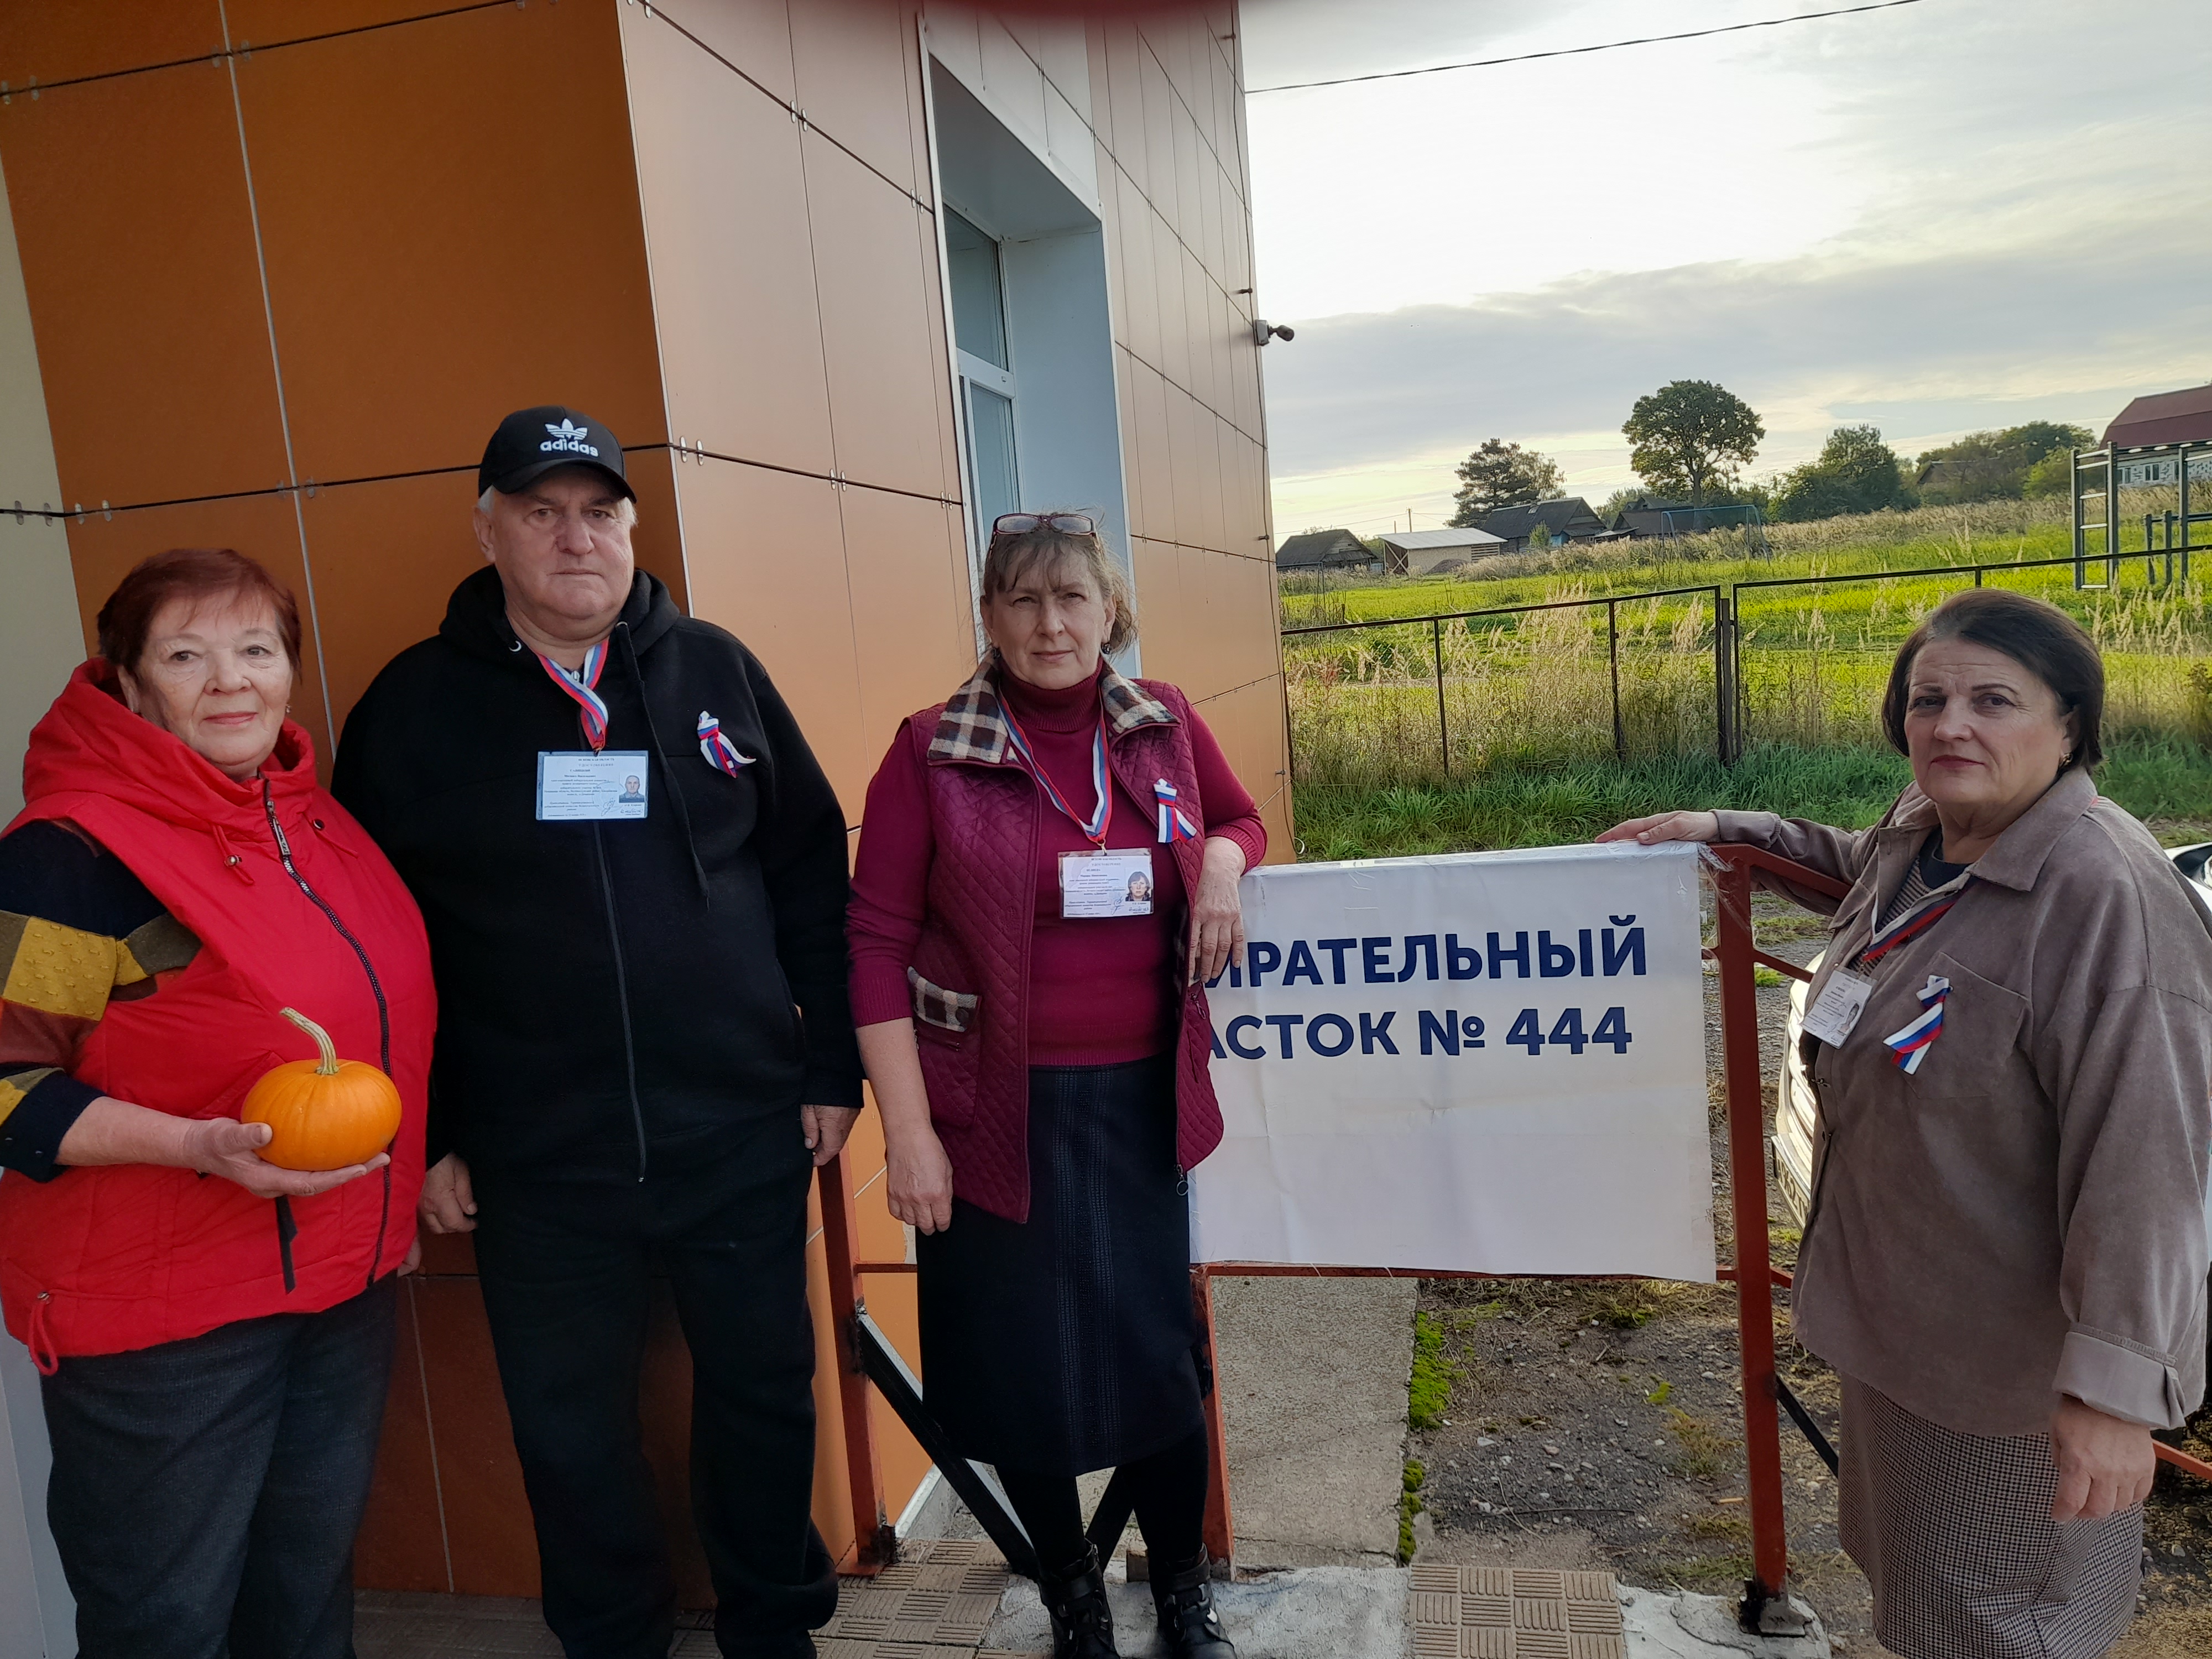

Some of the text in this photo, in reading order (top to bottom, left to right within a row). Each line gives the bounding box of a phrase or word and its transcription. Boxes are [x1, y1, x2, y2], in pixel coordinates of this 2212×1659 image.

[540, 439, 599, 457] adidas
[1418, 1009, 1485, 1057] №
[1505, 1006, 1632, 1056] 444
